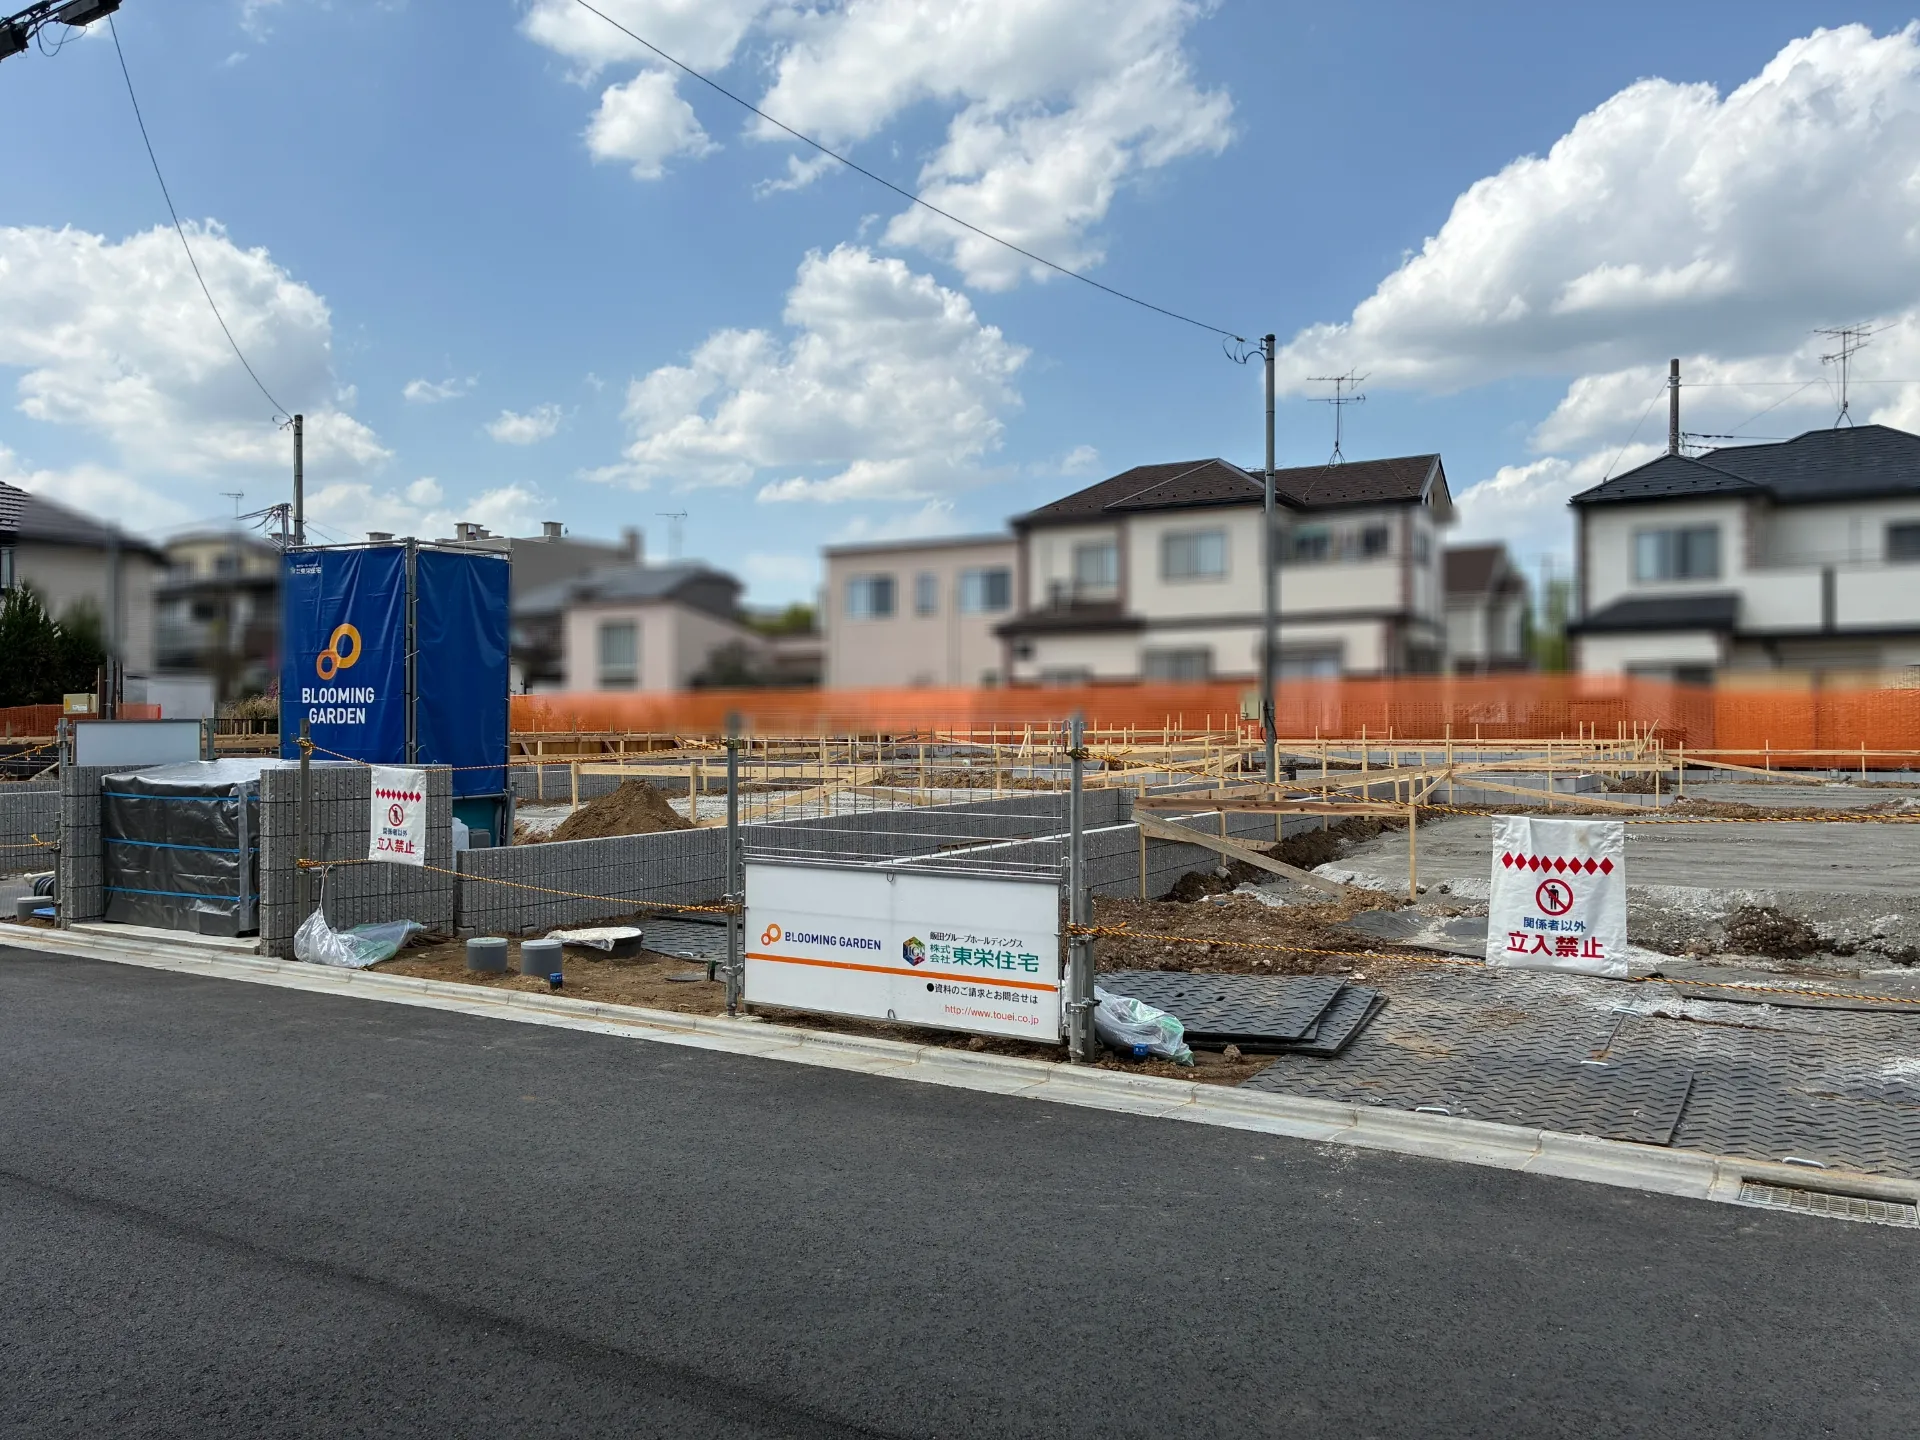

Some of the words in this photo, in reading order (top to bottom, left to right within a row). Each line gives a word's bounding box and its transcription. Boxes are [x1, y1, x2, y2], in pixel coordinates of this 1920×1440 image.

[302, 687, 375, 704] BLOOMING
[309, 707, 366, 724] GARDEN
[376, 837, 415, 854] 立入禁止
[1523, 916, 1587, 933] 関係者以外
[785, 931, 837, 946] BLOOMING
[839, 936, 881, 951] GARDEN
[1506, 930, 1605, 959] 立入禁止
[952, 946, 1039, 973] 東栄住宅
[944, 1004, 1039, 1026] http://www.touei.co.jp
